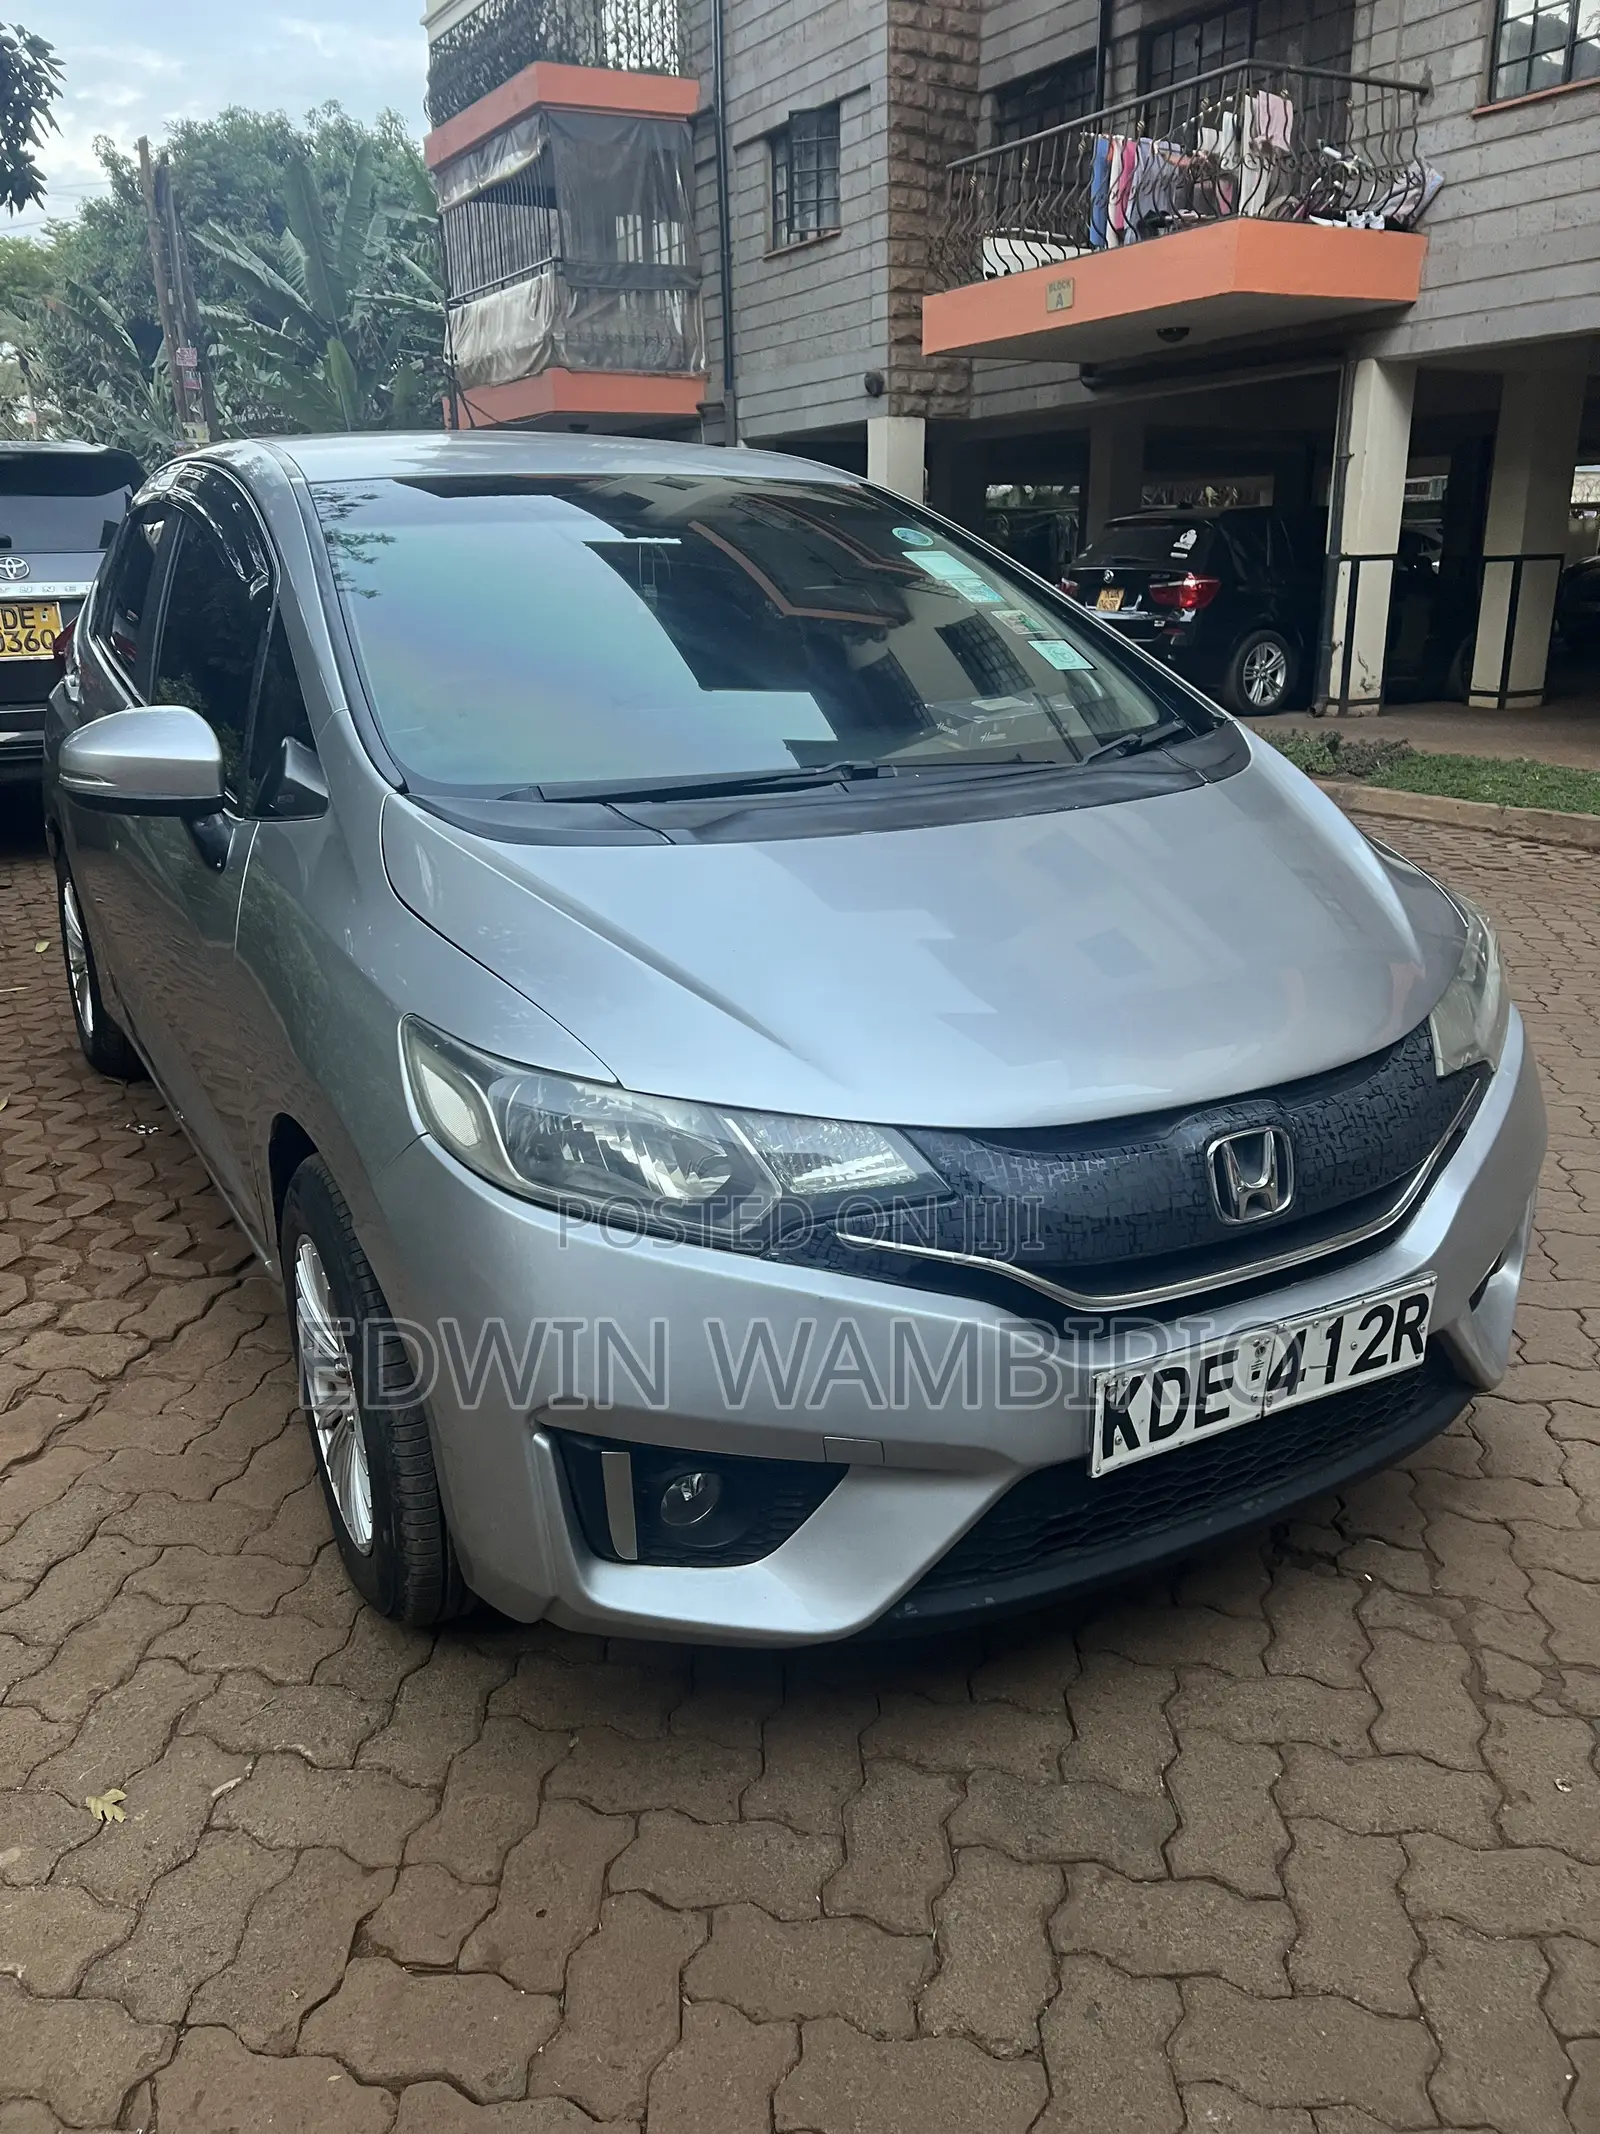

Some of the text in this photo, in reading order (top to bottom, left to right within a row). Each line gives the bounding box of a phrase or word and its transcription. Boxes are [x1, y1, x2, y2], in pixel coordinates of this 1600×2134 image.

[1048, 279, 1071, 294] BLOCK
[1055, 292, 1064, 308] A
[0, 606, 36, 630] DE
[1101, 1292, 1430, 1460] KDE 412R
